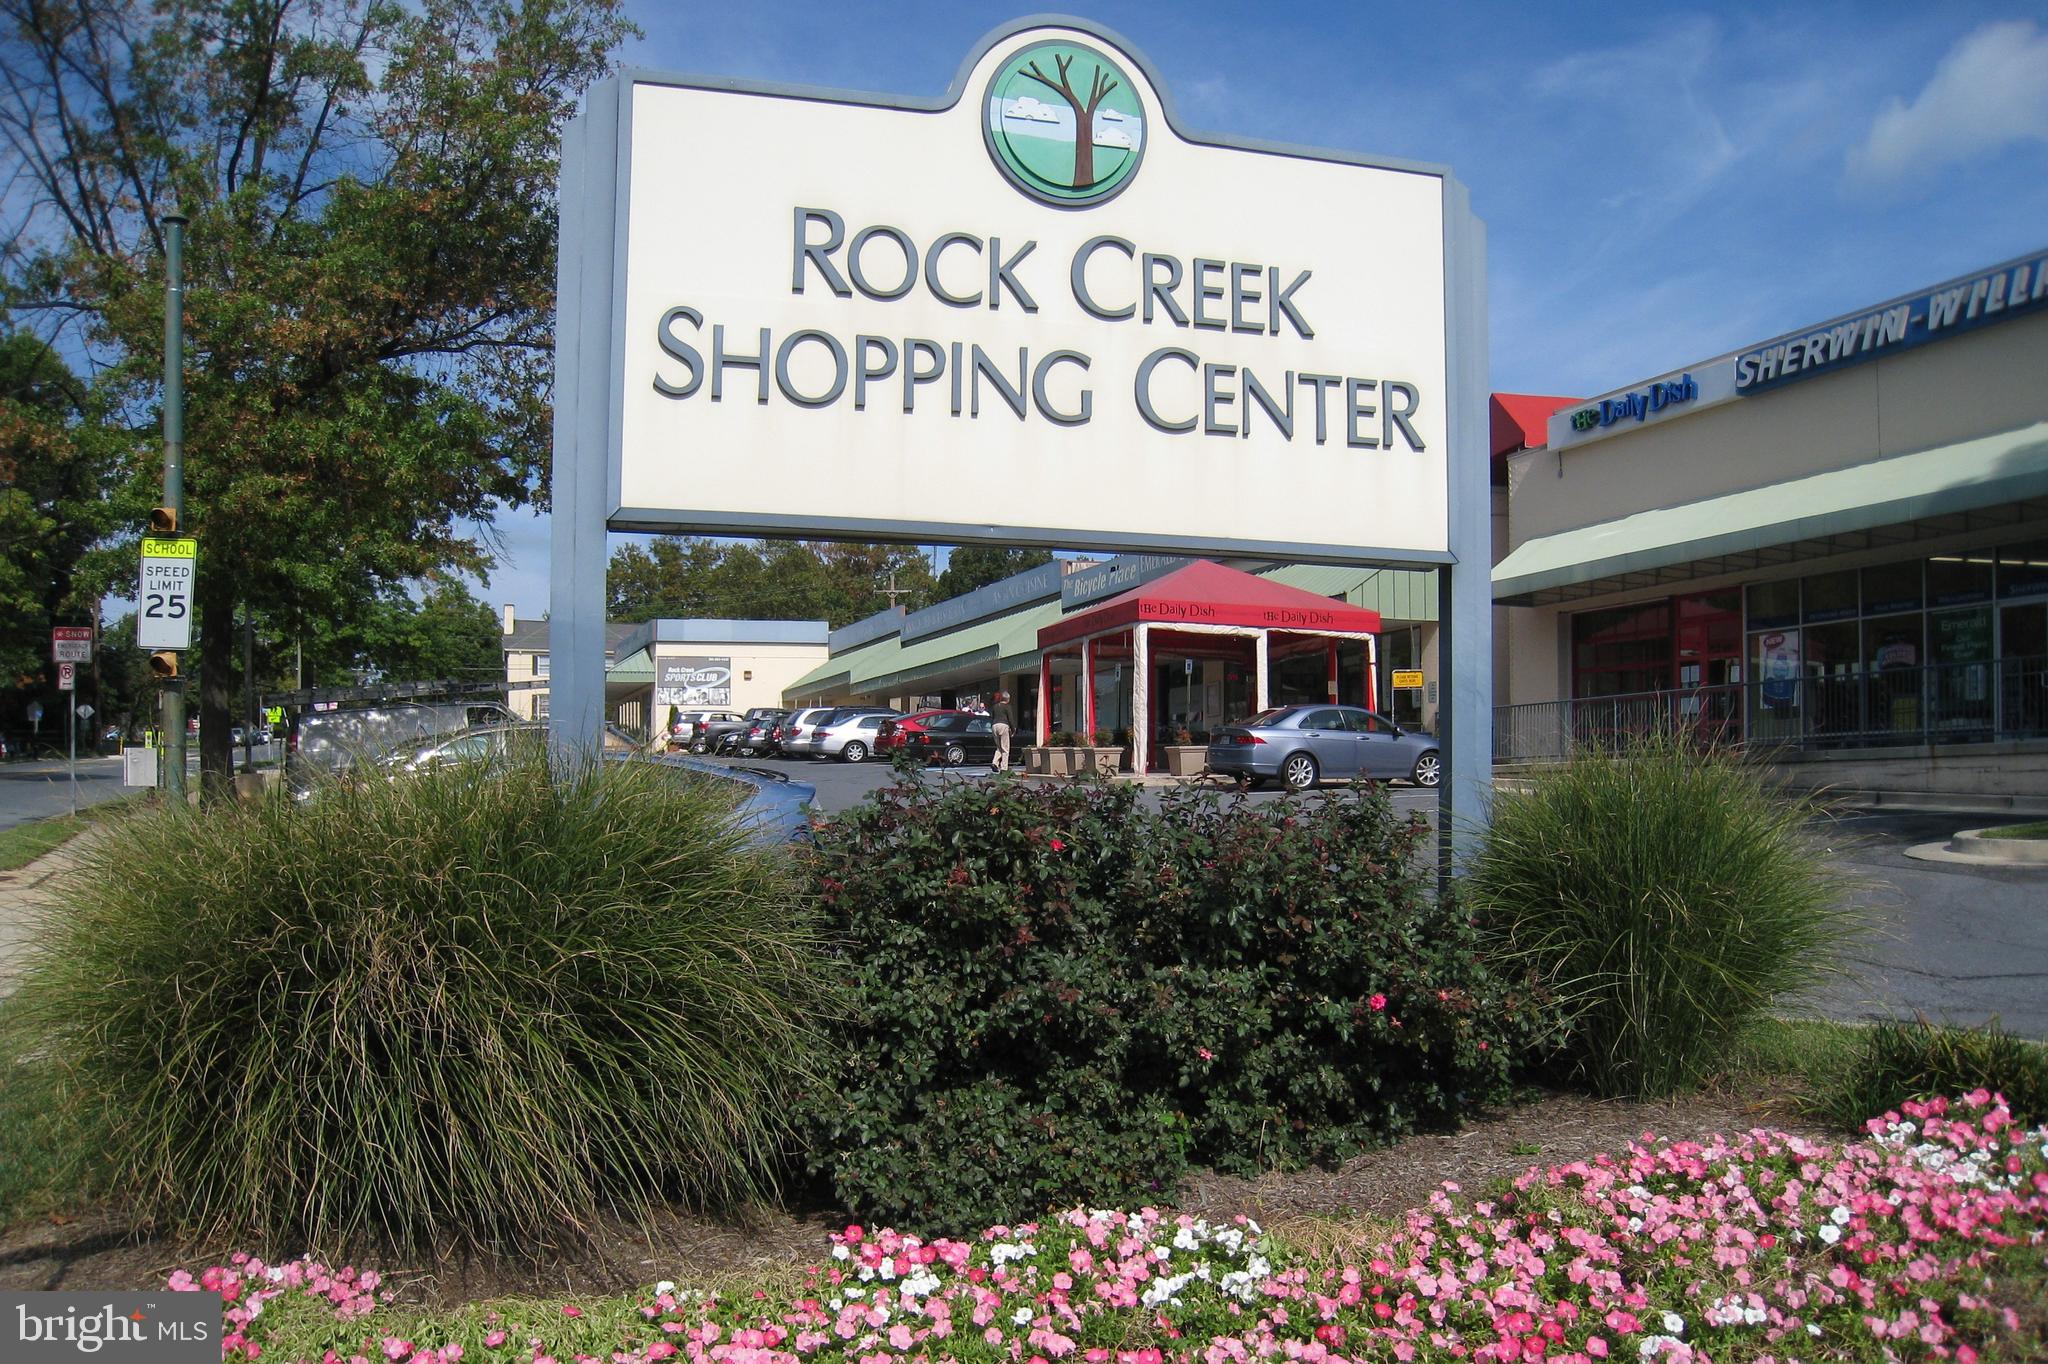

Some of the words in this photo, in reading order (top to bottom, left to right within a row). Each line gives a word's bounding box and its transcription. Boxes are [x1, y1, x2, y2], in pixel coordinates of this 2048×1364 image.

[792, 206, 1039, 314] ROCK
[1070, 234, 1315, 340] CREEK
[652, 305, 1093, 427] SHOPPING
[1134, 346, 1427, 453] CENTER
[1599, 392, 1649, 427] Daily
[1648, 373, 1699, 412] Dish
[145, 543, 192, 555] SCHOOL
[145, 566, 190, 578] SPEED
[150, 580, 184, 591] LIMIT
[1074, 572, 1106, 598] Bicycle
[1109, 565, 1137, 585] Place
[145, 593, 186, 619] 25
[1159, 603, 1187, 618] Daily
[1189, 604, 1215, 617] Dish
[1281, 610, 1307, 625] Daily
[1309, 610, 1334, 624] Dish
[65, 630, 90, 638] SNOW
